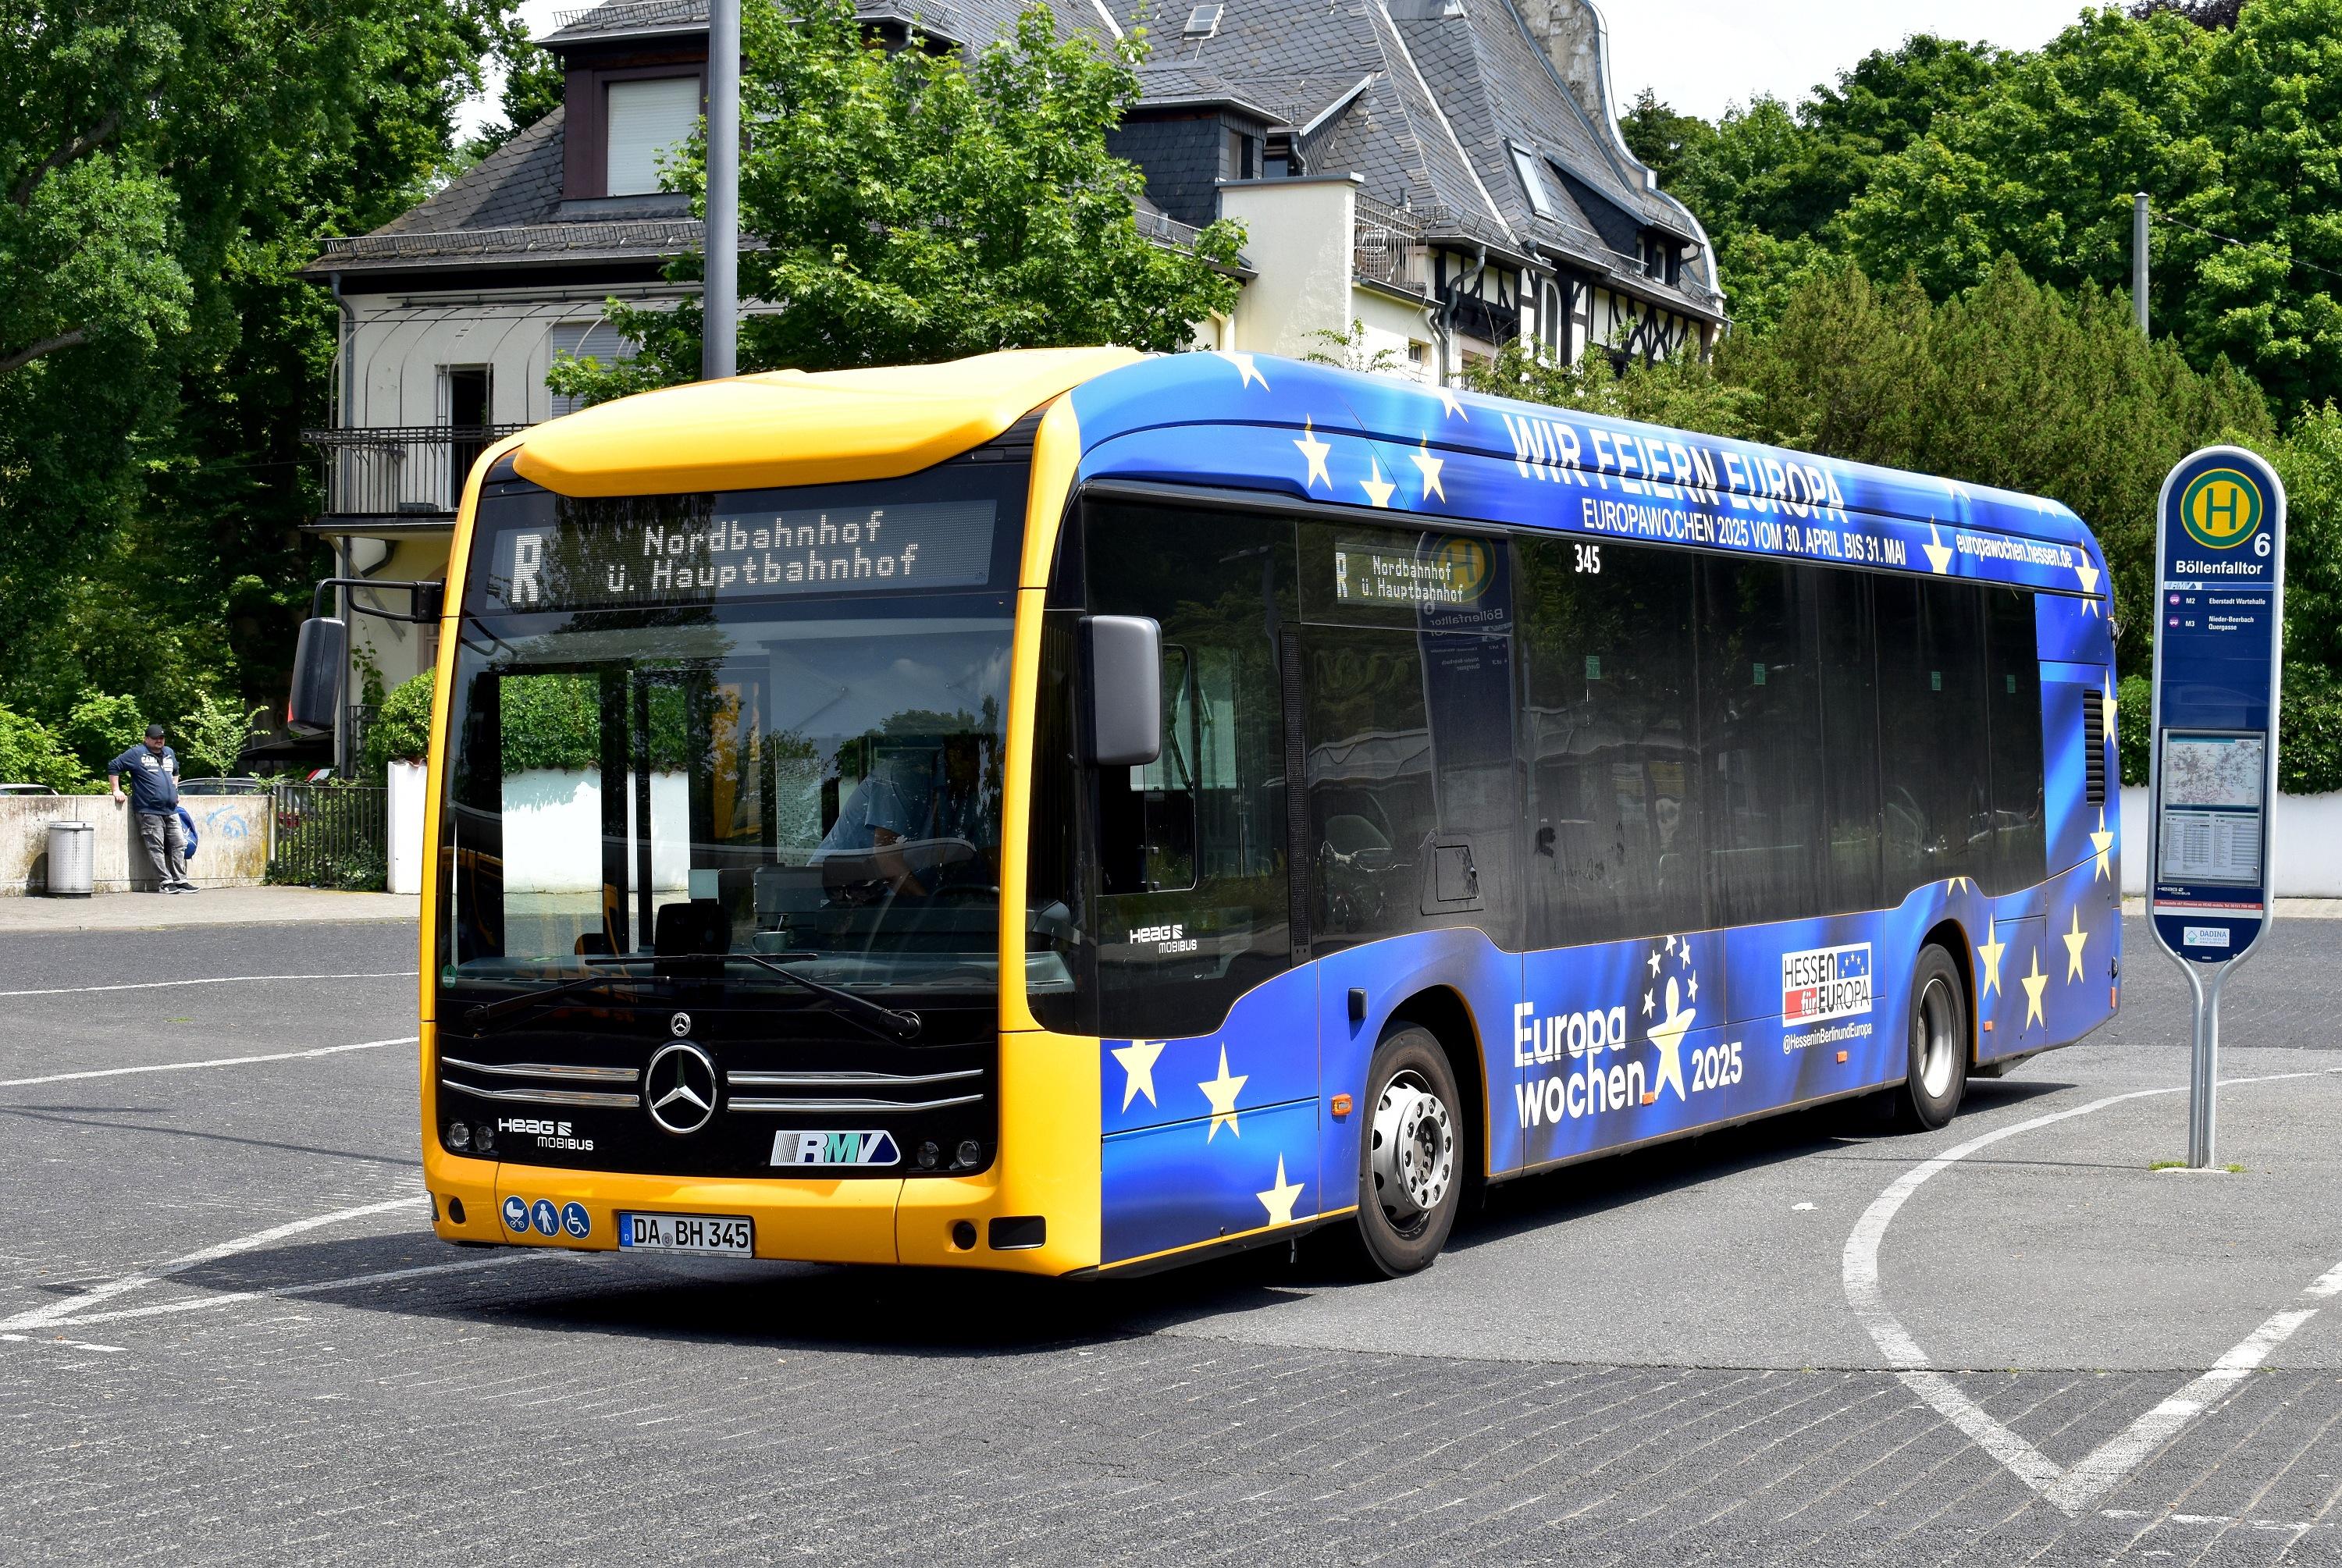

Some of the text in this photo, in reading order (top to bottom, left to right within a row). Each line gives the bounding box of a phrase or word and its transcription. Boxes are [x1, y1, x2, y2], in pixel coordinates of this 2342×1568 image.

[1501, 412, 1849, 524] WIR FEIERN EUROPA
[2205, 488, 2237, 530] H
[644, 510, 884, 556] Nordbahnhof
[1582, 497, 1906, 566] EUROPAWOCHEN 2025 VOM 30. APRIL BIS 31. MAI
[2254, 533, 2271, 556] 6
[512, 534, 542, 603] R
[608, 544, 918, 592] ü. Hauptbahnhof
[1372, 555, 1451, 581] Nordbahnhof
[1574, 543, 1600, 574] 345
[1956, 534, 2073, 569] europawochen.hessen.de
[2175, 560, 2263, 575] Böllenfalltor
[1335, 552, 1348, 598] R
[1361, 578, 1463, 603] ü. Hauptbahnhof
[2199, 930, 2226, 938] DADINA
[1801, 980, 1870, 1015] für EUROPA
[1514, 1001, 1626, 1067] Europa
[1783, 1022, 1872, 1054] @HesseninBerlinundEuropa
[1514, 1041, 1742, 1129] wochen 2025
[537, 1136, 594, 1151] MOBIBUS
[795, 1133, 885, 1163] RMV
[634, 1218, 660, 1244] DA
[675, 1220, 703, 1246] BH
[708, 1221, 749, 1249] 345
